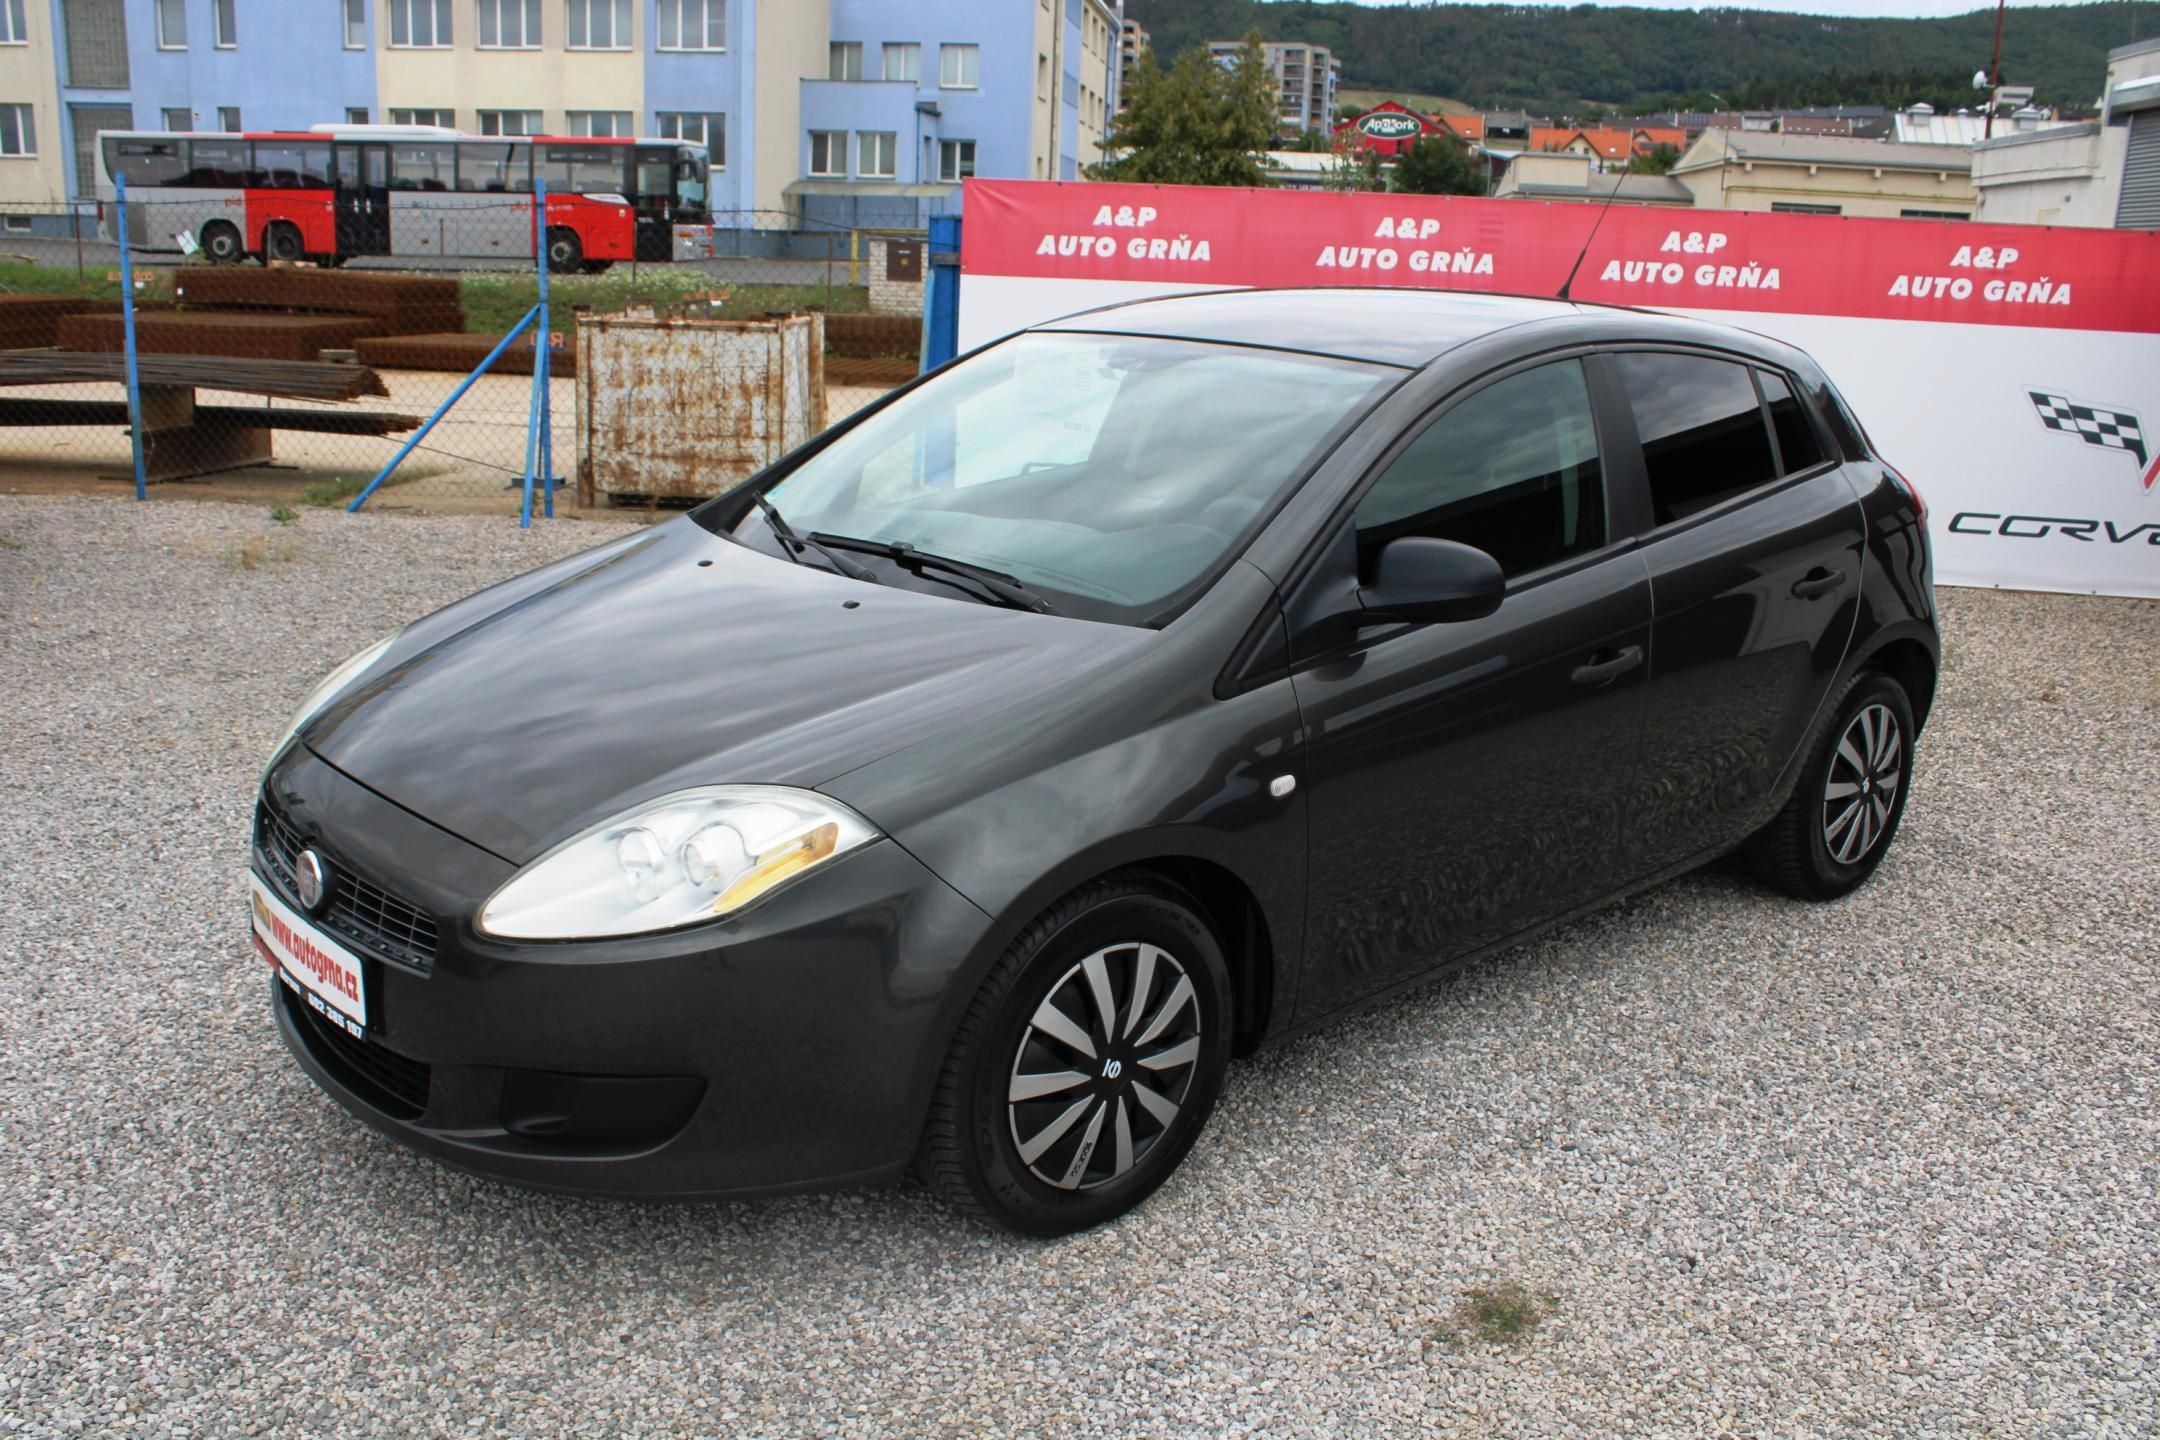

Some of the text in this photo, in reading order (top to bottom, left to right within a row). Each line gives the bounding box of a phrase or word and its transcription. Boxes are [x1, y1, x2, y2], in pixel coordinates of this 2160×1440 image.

[1093, 205, 1157, 227] A&P
[1375, 217, 1440, 239] A&P
[1036, 234, 1211, 261] AUTO GRŇA
[1661, 231, 1727, 253] A&P
[1316, 246, 1494, 274] AUTO GRŇA
[1950, 246, 2018, 268] A&P
[1601, 260, 1780, 289] AUTO GRŇA
[1888, 276, 2071, 304] AUTO GRŇA
[1949, 512, 2160, 546] CORV
